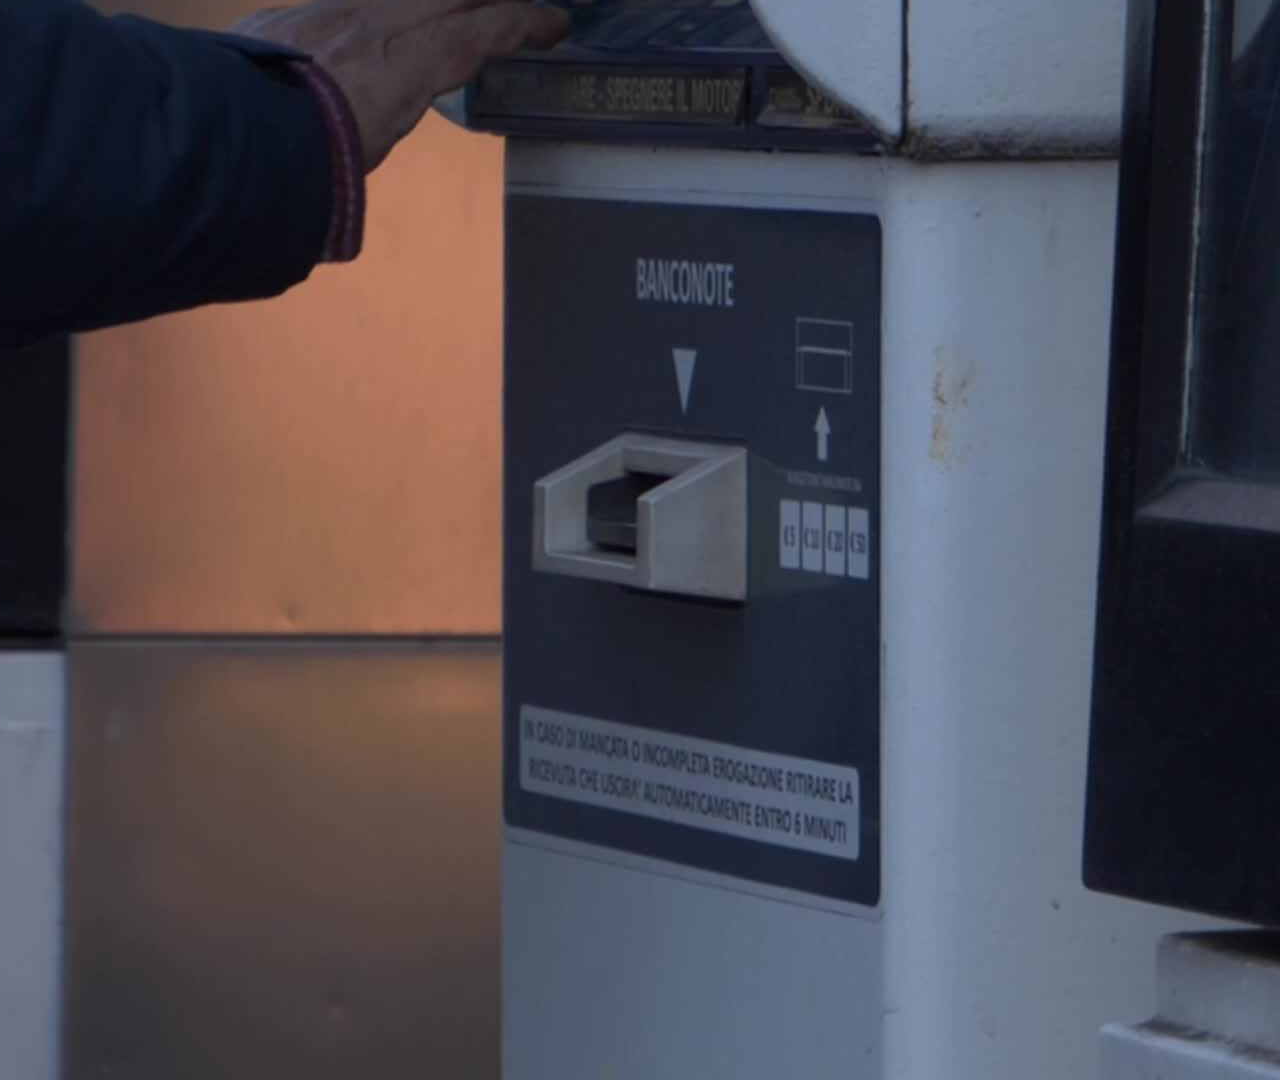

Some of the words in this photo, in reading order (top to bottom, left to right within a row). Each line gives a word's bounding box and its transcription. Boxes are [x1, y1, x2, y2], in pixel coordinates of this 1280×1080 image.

[607, 76, 673, 112] SPEGNERE
[675, 79, 689, 112] IL
[636, 258, 734, 307] BANCONOTE
[536, 721, 563, 749] CASO
[578, 728, 629, 761] MANCATA
[631, 739, 641, 763] O
[642, 743, 711, 778] INCOMPLETA
[713, 755, 784, 793] EROGAZIONE
[786, 770, 836, 803] RITIRARE
[838, 779, 854, 806] LA
[528, 756, 577, 786] RICEVUTA
[579, 767, 599, 793] CHE
[642, 781, 753, 826] AUTOMATICAMENTE
[754, 803, 793, 834] ENTRO
[794, 812, 802, 836] 6
[804, 813, 848, 845] MINUTI
